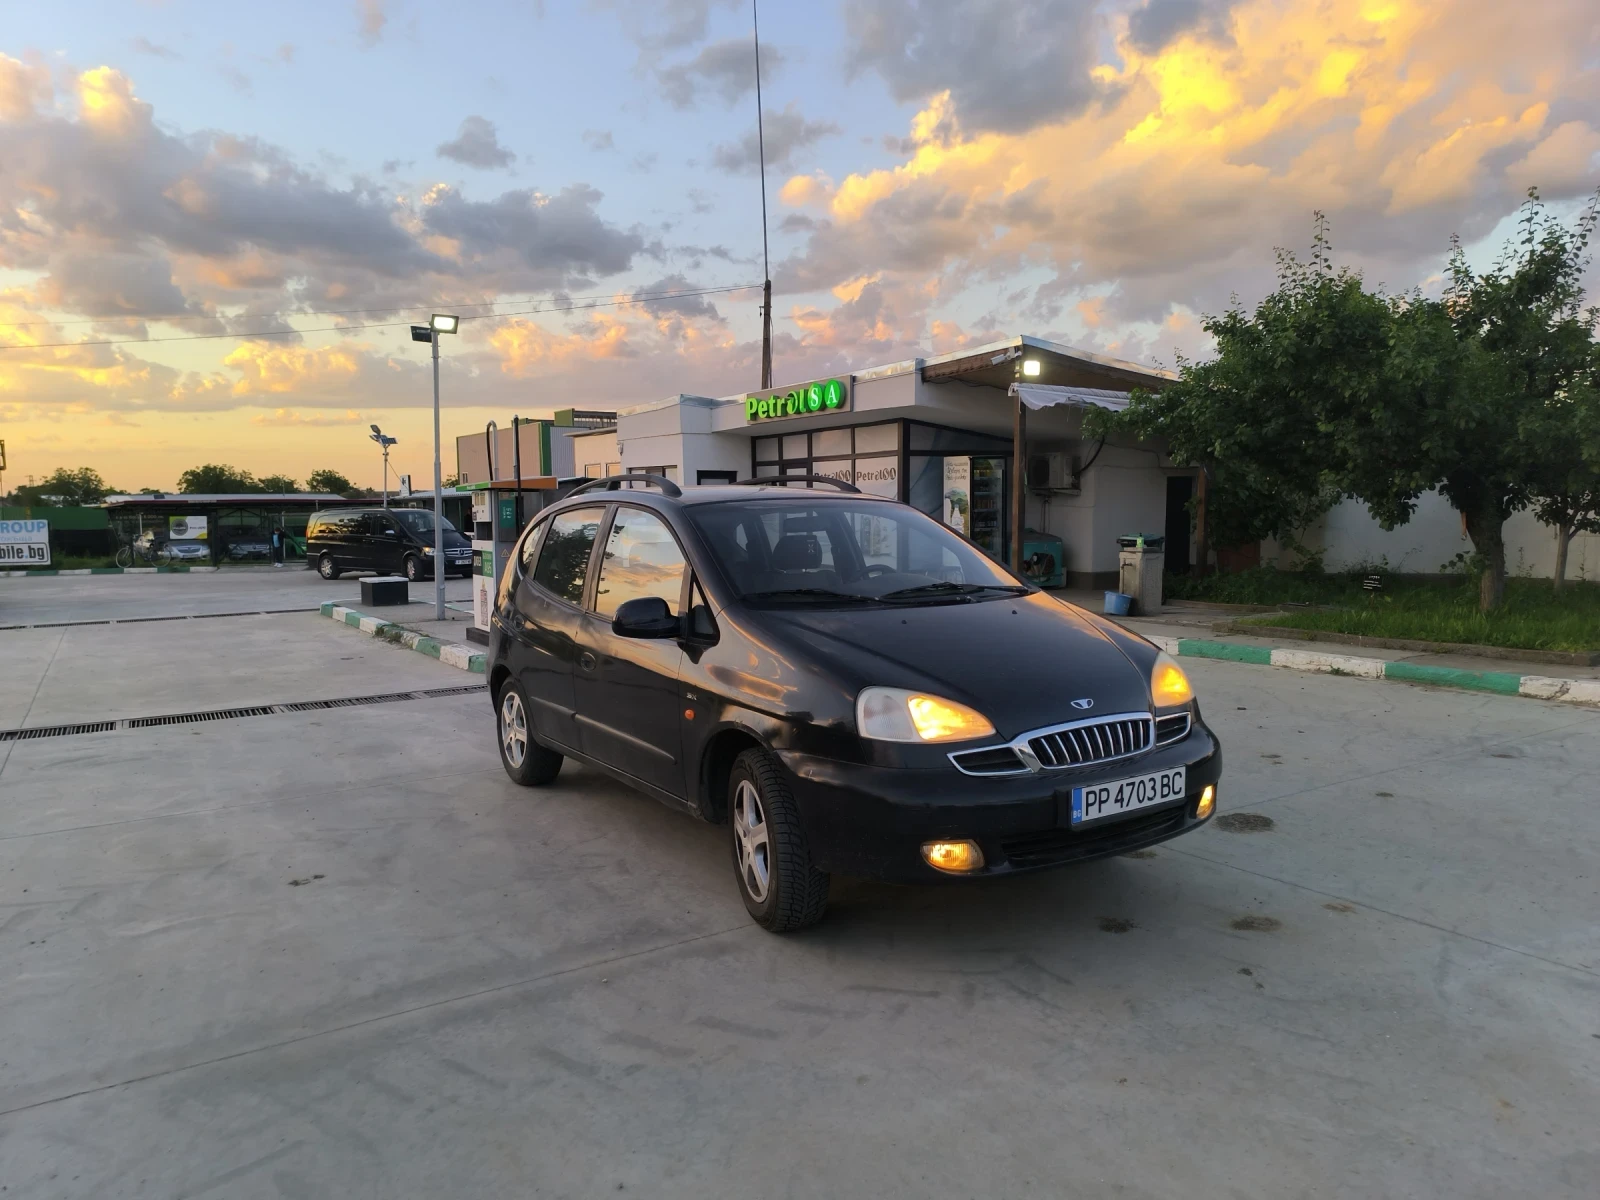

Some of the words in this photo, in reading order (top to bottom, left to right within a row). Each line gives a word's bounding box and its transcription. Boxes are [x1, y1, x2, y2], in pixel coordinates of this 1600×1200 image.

[1085, 787, 1110, 816] PP
[1114, 777, 1157, 808] 4703
[1160, 771, 1183, 799] BC
[1072, 809, 1082, 819] BG
